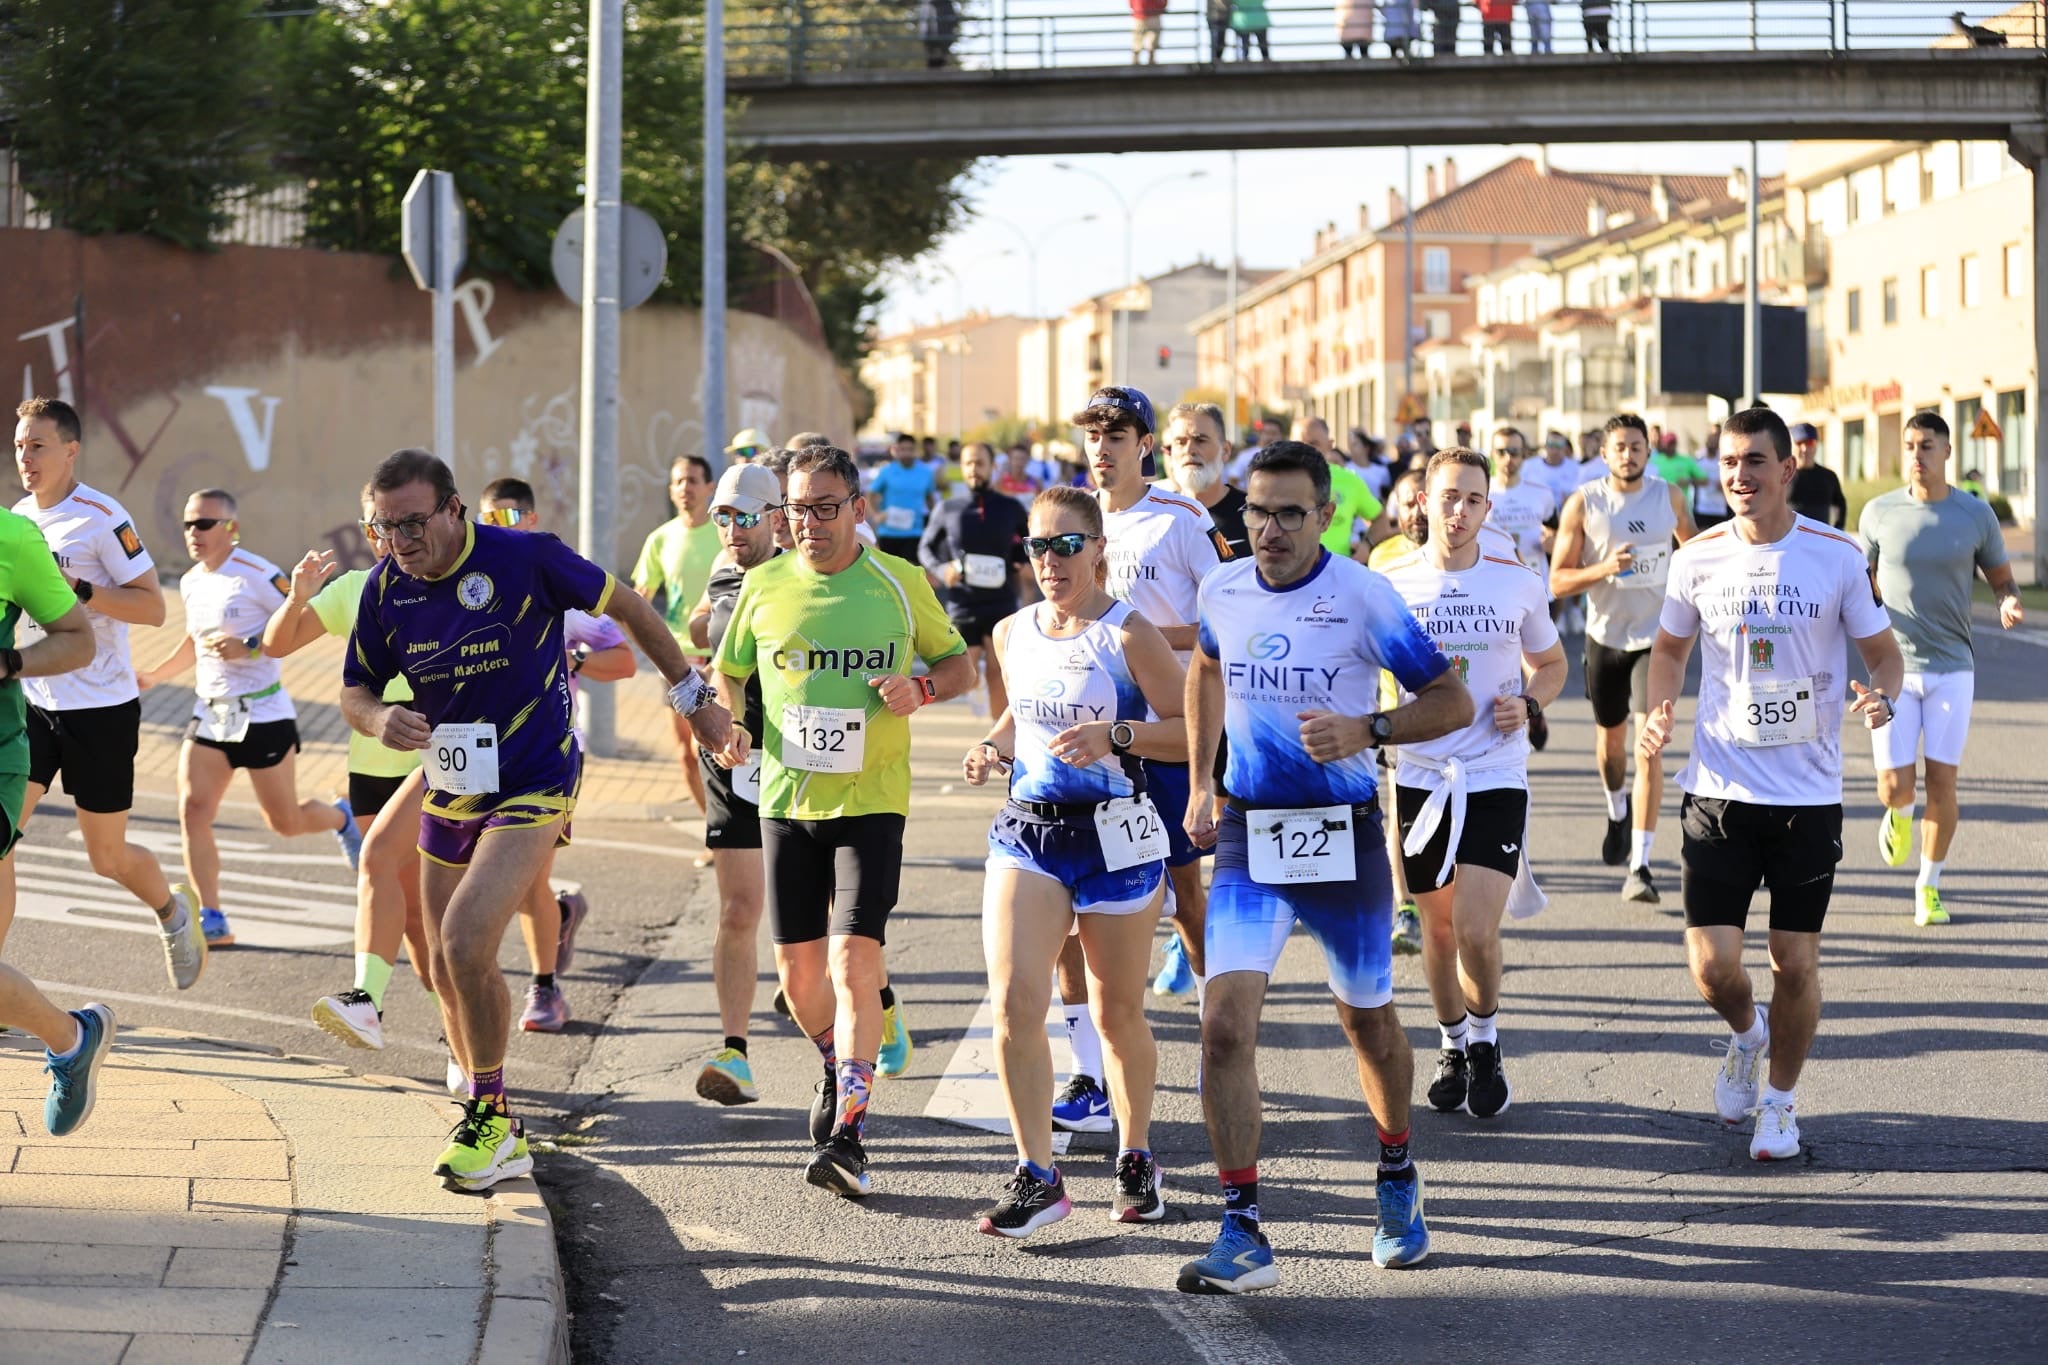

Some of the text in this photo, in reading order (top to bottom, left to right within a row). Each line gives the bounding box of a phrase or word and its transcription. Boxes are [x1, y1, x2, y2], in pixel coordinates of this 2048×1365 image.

[203, 385, 282, 472] V
[1118, 565, 1160, 581] CIVIL
[1741, 584, 1801, 597] CARRERA
[1416, 605, 1497, 618] III CARRERA
[1778, 600, 1822, 619] CIVIL
[1426, 619, 1468, 636] RDIA
[1750, 624, 1792, 634] Iberdrola
[406, 639, 440, 655] Jamón
[460, 640, 500, 658] PRIM
[1444, 642, 1489, 652] Iberdrola
[454, 657, 510, 678] Macotera
[772, 642, 896, 678] campal
[1223, 662, 1341, 692] FINITY
[1262, 694, 1333, 704] ENERGÉTICA
[1014, 698, 1106, 722] FINITY
[1747, 701, 1798, 726] 359
[799, 726, 846, 752] 132
[437, 746, 468, 772] 90
[1119, 815, 1160, 843] 124
[1272, 830, 1331, 860] 122
